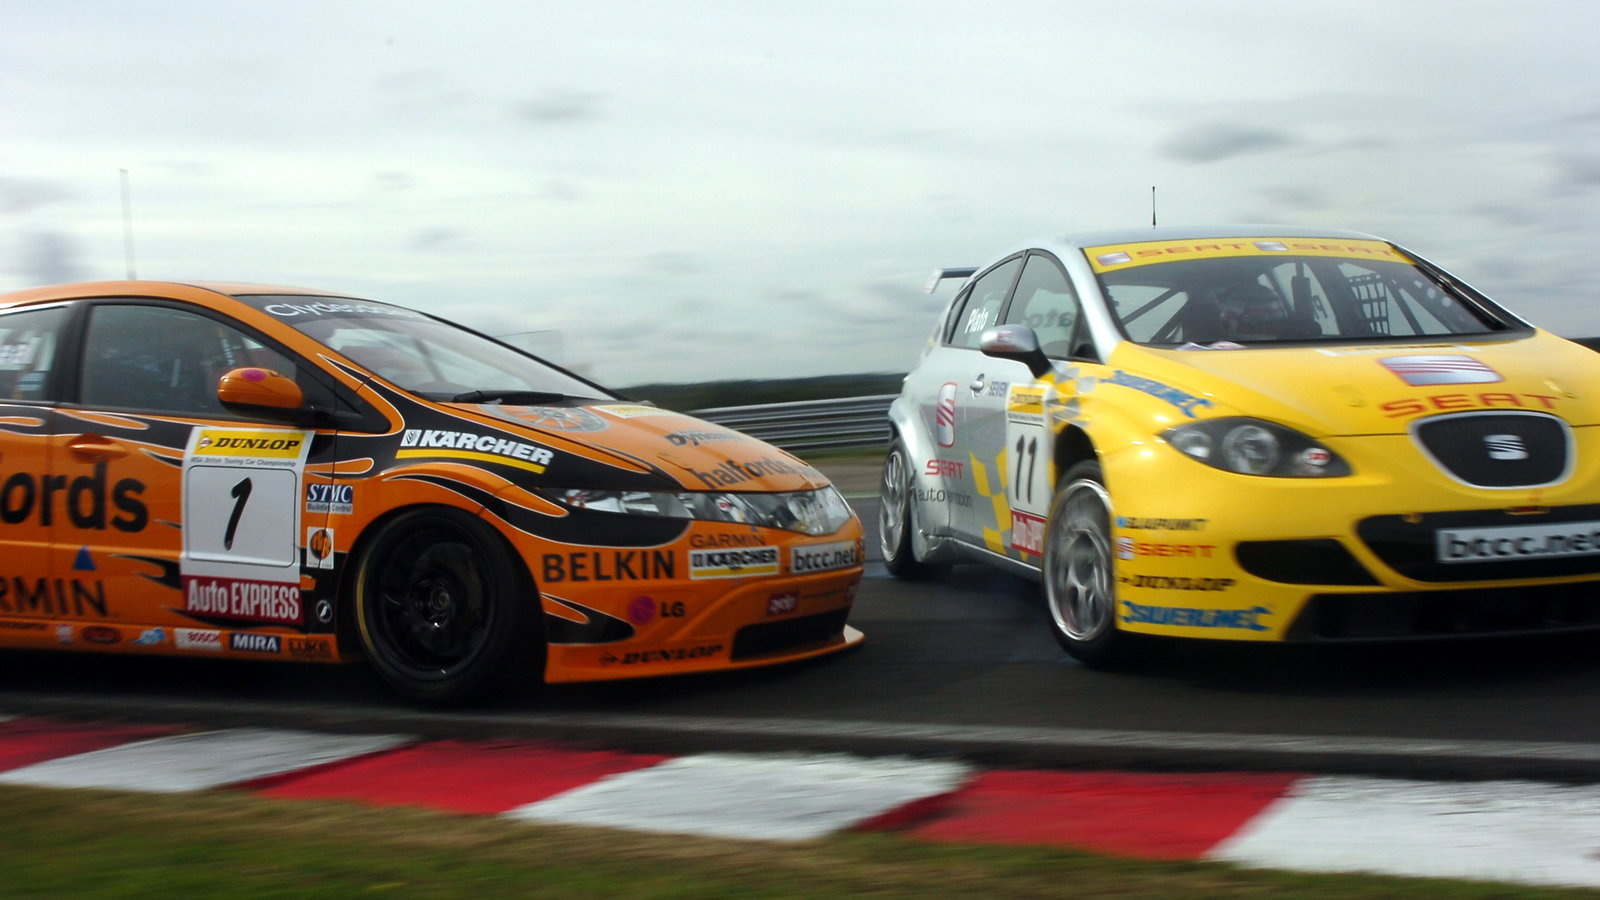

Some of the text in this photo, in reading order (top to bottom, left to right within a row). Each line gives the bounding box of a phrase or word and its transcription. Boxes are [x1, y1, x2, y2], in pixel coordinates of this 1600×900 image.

[1137, 243, 1244, 257] SEAT
[1379, 393, 1559, 418] SEAT
[214, 437, 300, 450] DUNLOP
[419, 429, 554, 466] KÄRCHER
[257, 460, 296, 468] Championship
[690, 455, 800, 490] halfords
[925, 459, 964, 479] SEAT
[1016, 435, 1038, 504] 11
[0, 461, 148, 533] ords
[224, 477, 252, 551] 1
[690, 534, 765, 548] GARMIN
[1138, 543, 1216, 558] SEAT
[543, 550, 675, 583] BELKIN
[795, 548, 857, 571] btcc.net
[1132, 575, 1236, 591] DUNLOP
[187, 578, 299, 620] Auto EXPRESS
[661, 601, 685, 618] LG
[233, 634, 278, 651] MIRA
